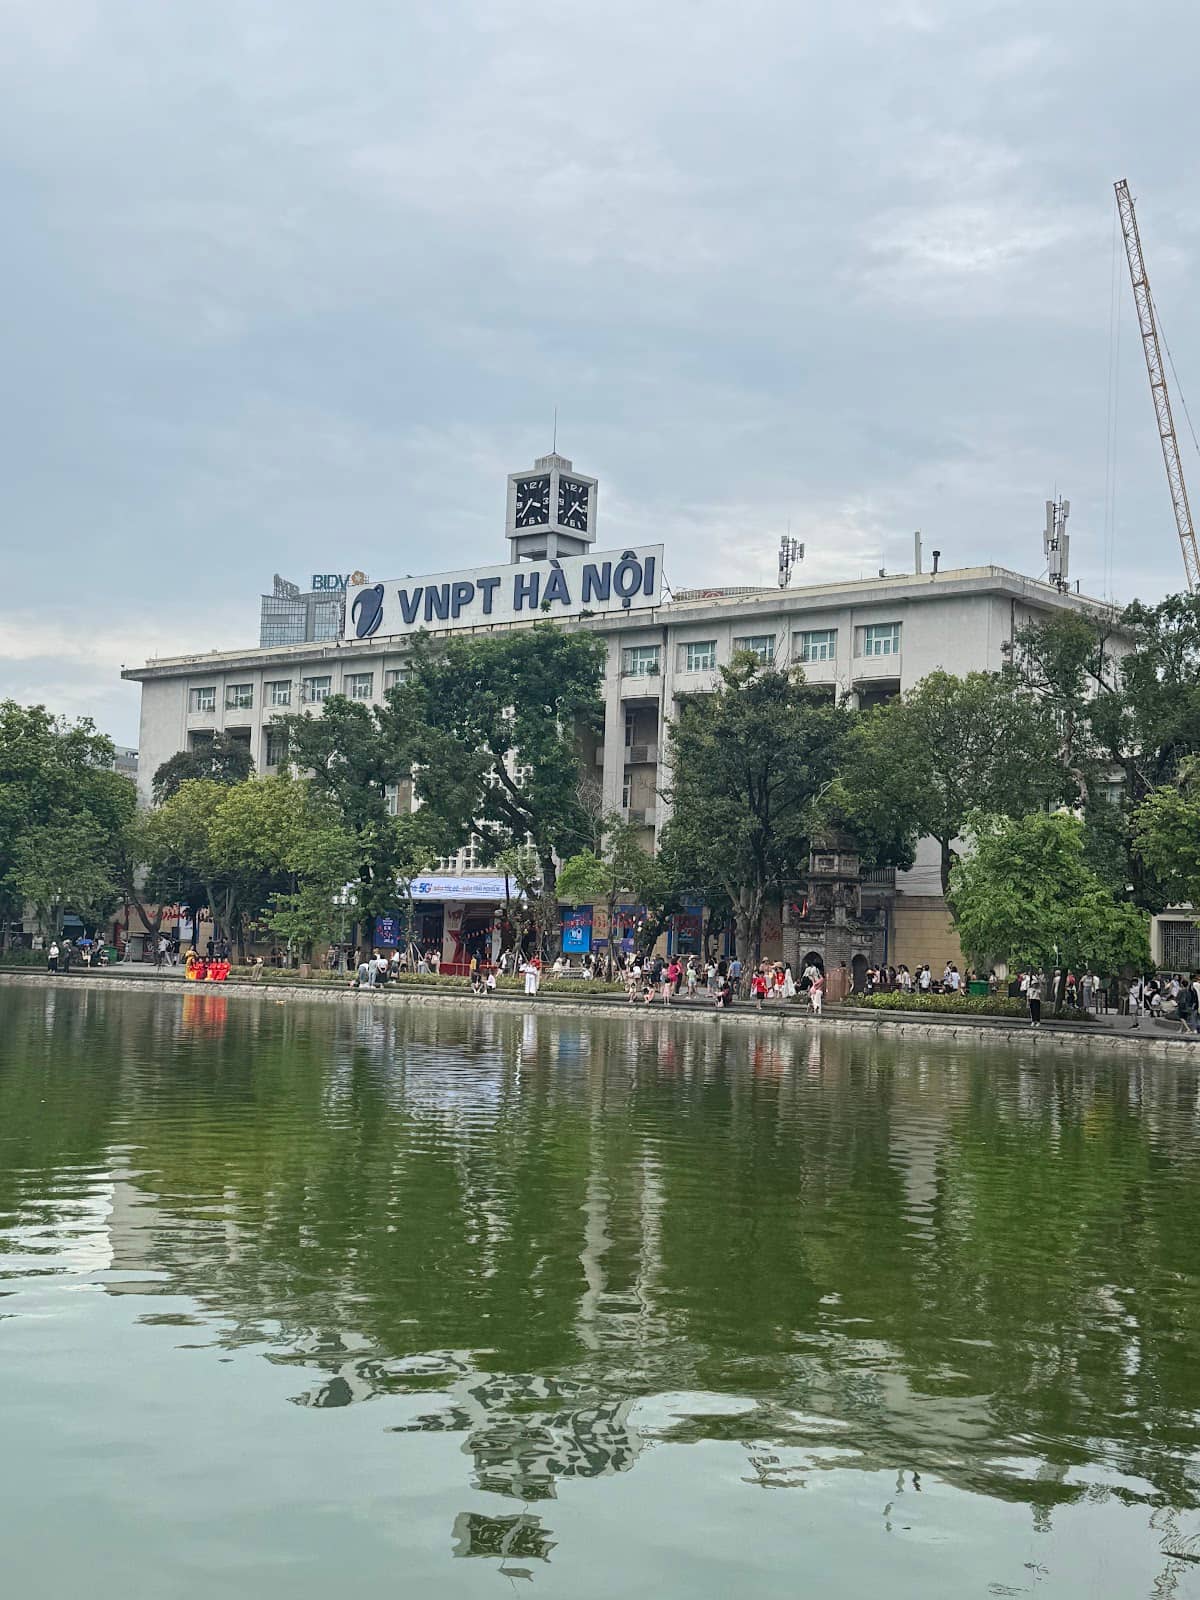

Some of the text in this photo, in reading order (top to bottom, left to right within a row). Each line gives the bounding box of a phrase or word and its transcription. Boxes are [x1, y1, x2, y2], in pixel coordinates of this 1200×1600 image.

[312, 574, 350, 590] BIDV
[397, 550, 656, 624] VNPT HÀ NỘI
